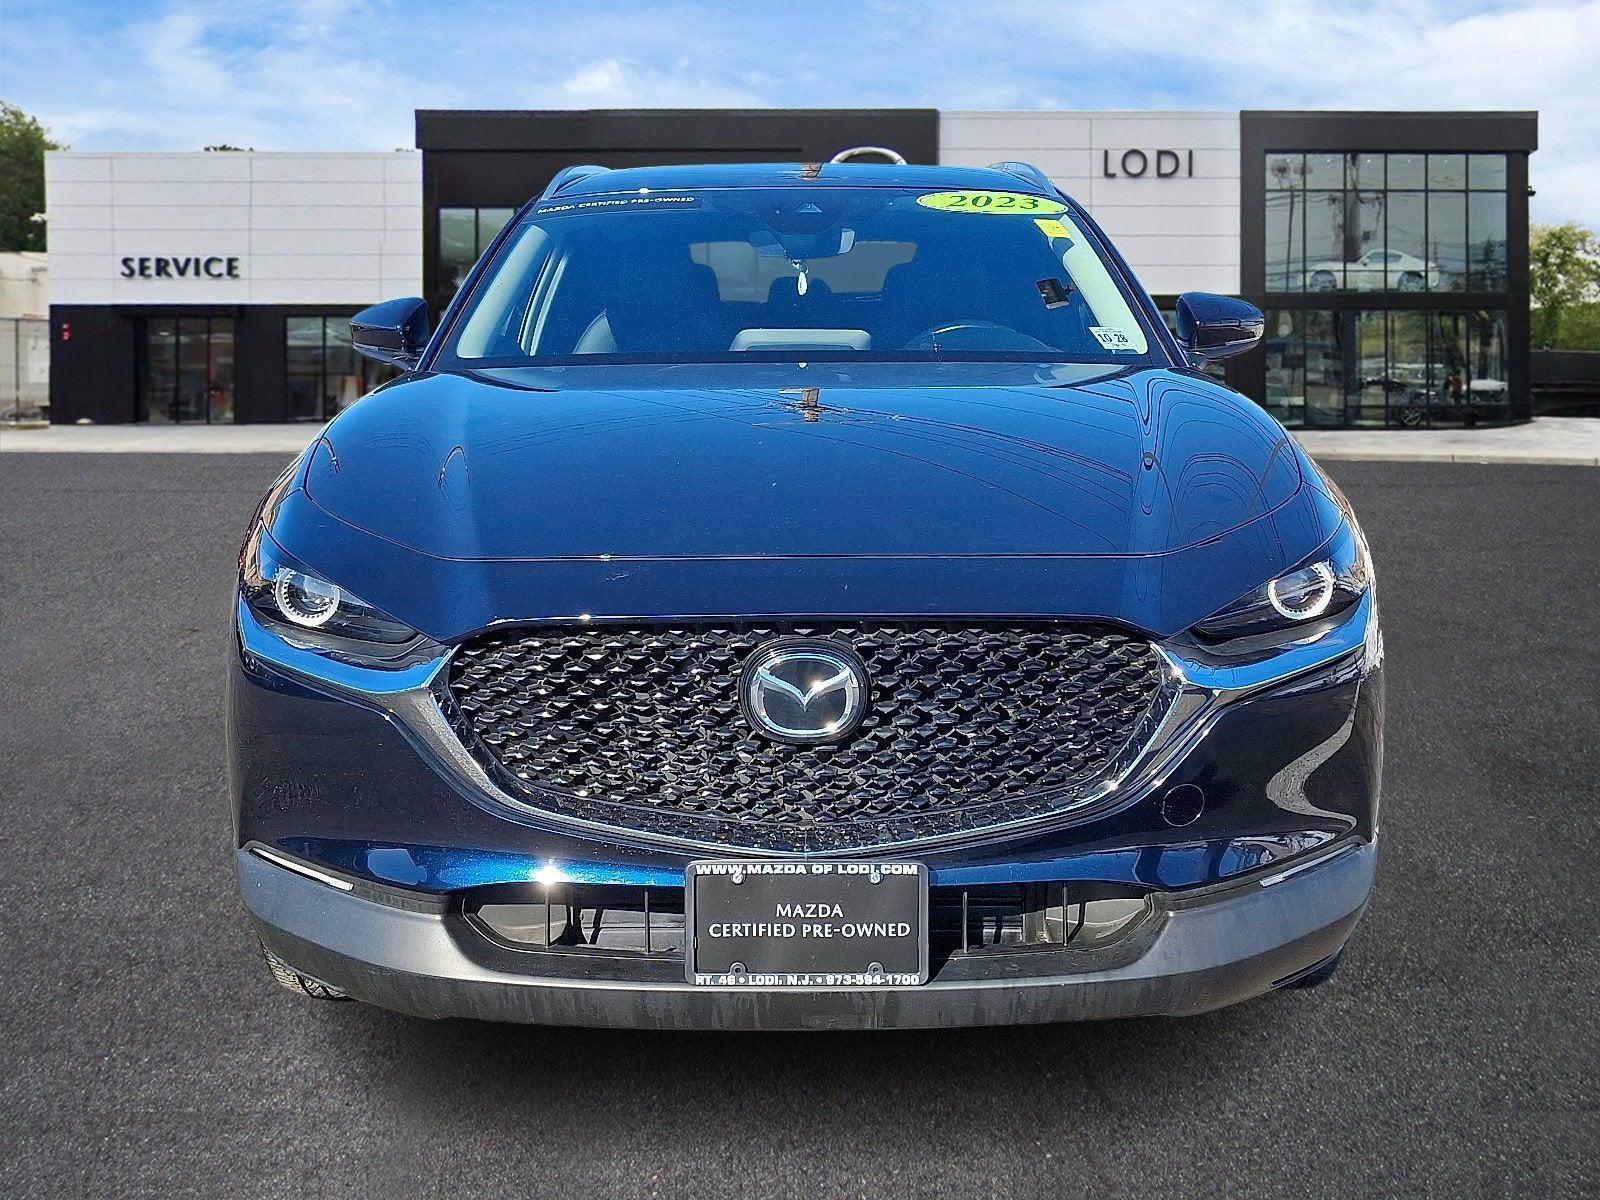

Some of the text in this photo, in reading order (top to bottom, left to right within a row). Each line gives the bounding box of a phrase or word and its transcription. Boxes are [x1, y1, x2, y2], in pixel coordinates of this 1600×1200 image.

[1103, 149, 1193, 179] LODI
[578, 199, 628, 208] CERTIFIED
[631, 196, 695, 204] PRE-OWNED
[948, 195, 1039, 210] 2023
[120, 256, 240, 279] SERVICE
[1097, 333, 1113, 343] 10
[695, 864, 918, 875] WWW.MAZDA OF LODI.COM
[776, 903, 844, 918] MAZDA
[708, 922, 911, 938] CERTIFIED PRE-OWNED
[695, 975, 715, 985] RT.
[718, 975, 736, 985] 46
[787, 975, 813, 985] N.J.
